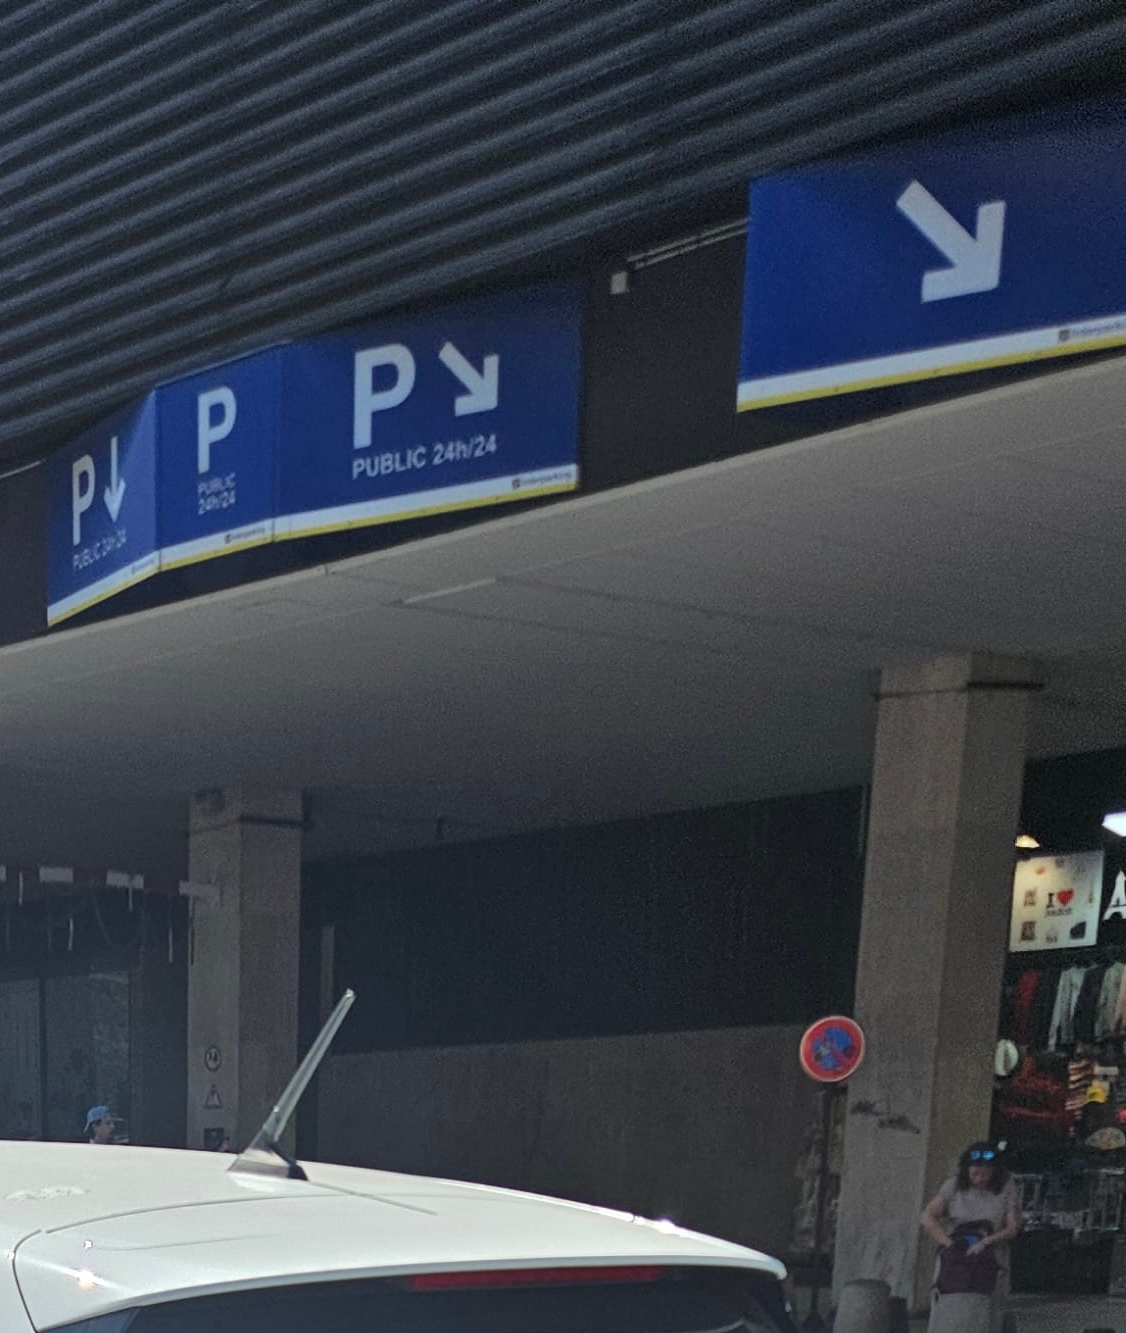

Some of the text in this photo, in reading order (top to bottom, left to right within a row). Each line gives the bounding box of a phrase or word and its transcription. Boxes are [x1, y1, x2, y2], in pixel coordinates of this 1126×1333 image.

[197, 386, 237, 475] P
[353, 343, 416, 450] P
[72, 454, 96, 546] P
[353, 433, 497, 481] PUBLIC 24h/24
